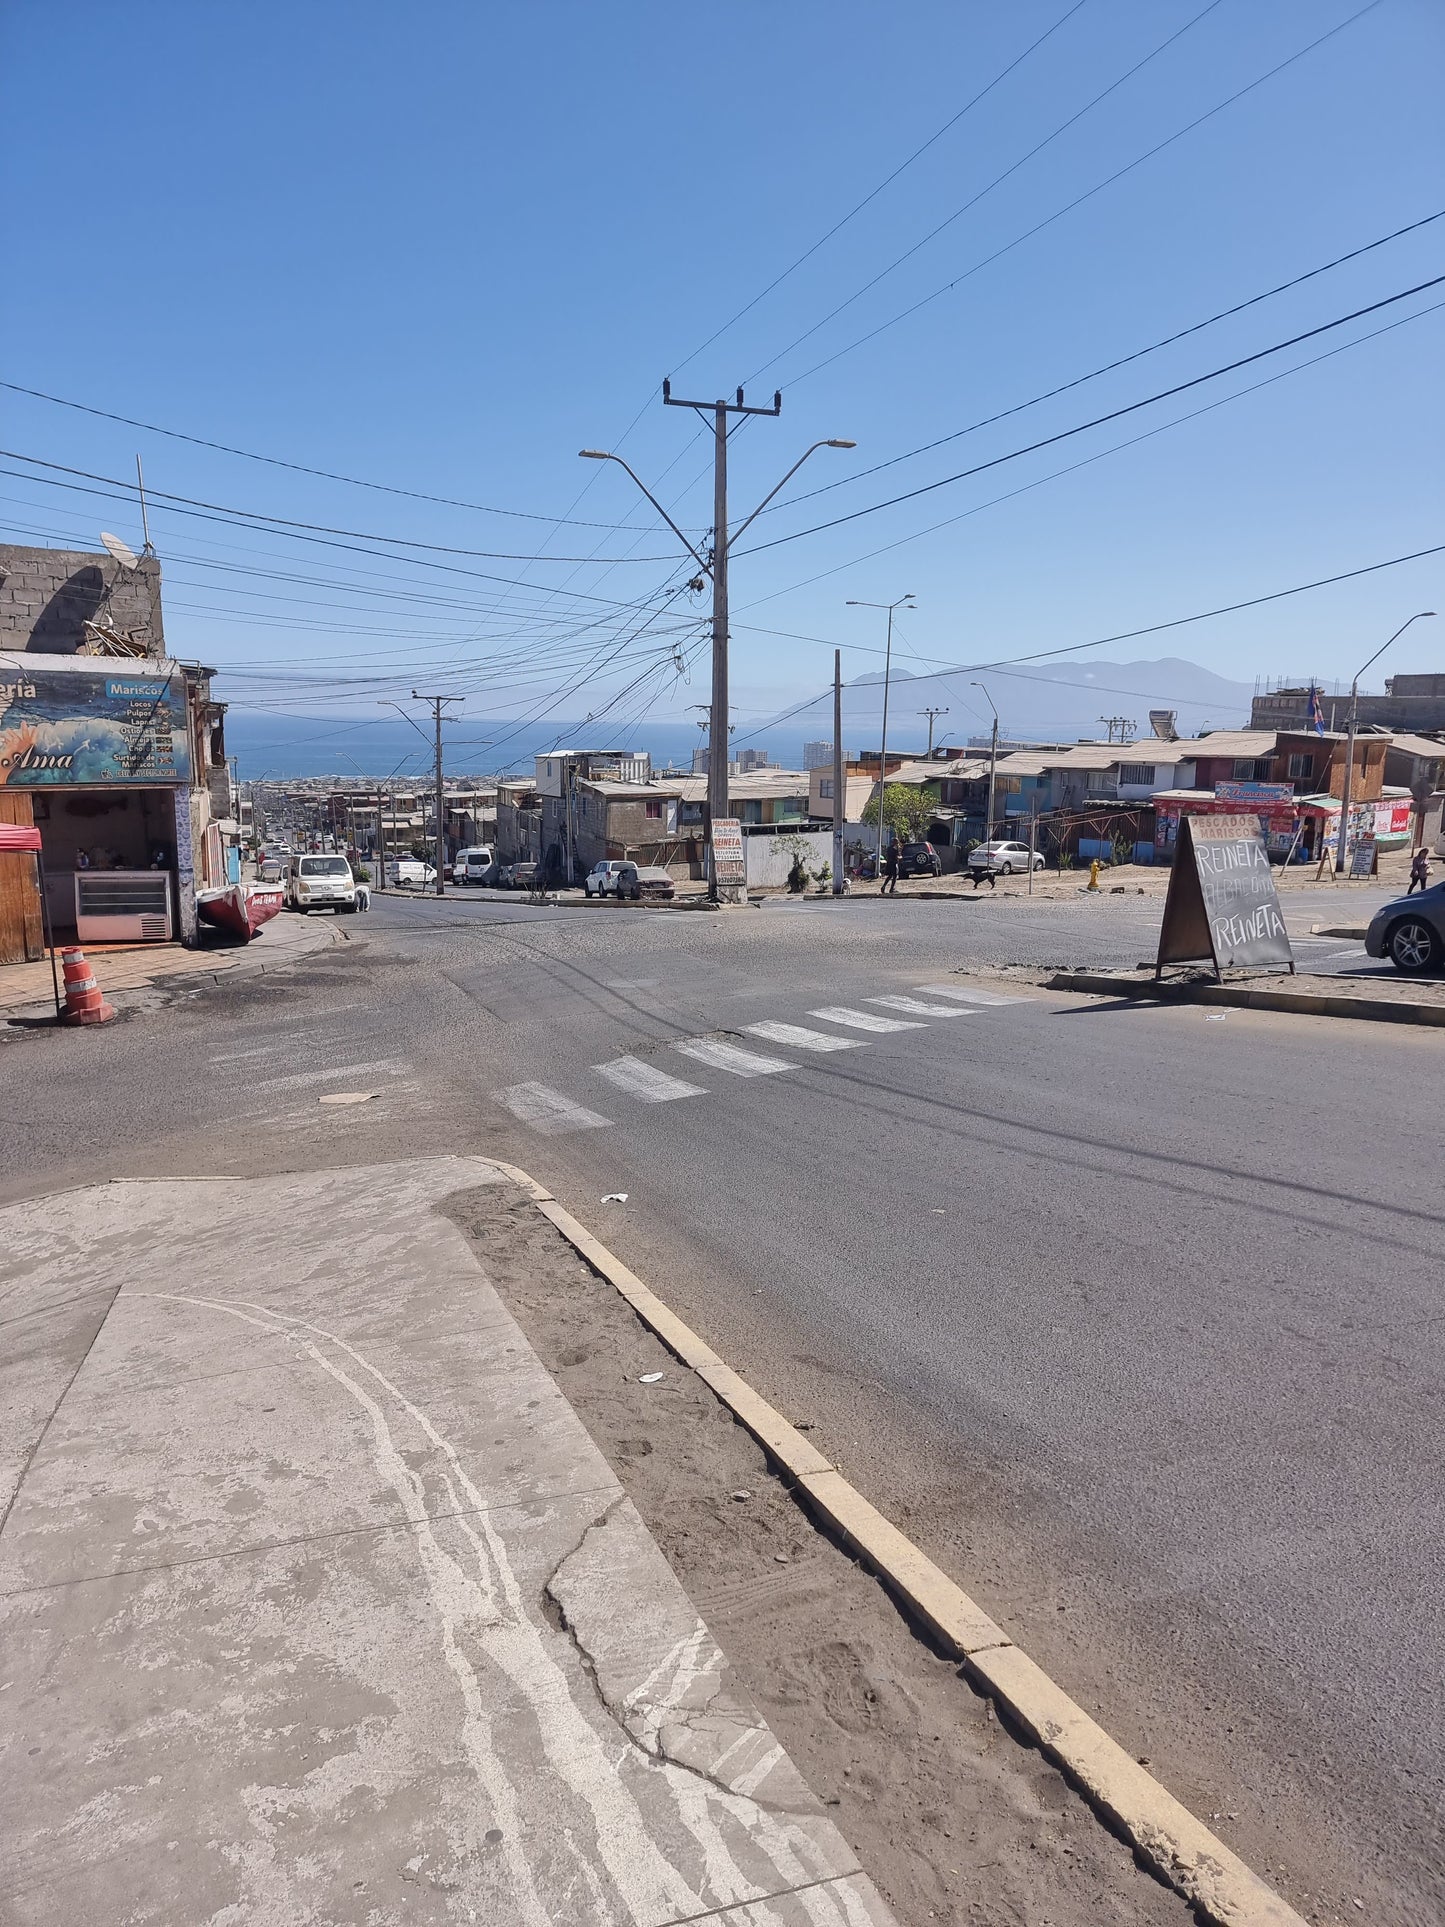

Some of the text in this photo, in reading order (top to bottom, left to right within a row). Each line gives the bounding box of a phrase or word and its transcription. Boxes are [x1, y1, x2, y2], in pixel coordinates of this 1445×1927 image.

[111, 684, 162, 696] Mariscos
[127, 710, 152, 718] Pulpos
[3, 744, 73, 769] Ama
[1193, 817, 1255, 828] PESCADOS
[1201, 827, 1259, 838] MARISCOS
[714, 837, 741, 846] REINETA
[1195, 840, 1269, 877] REINETA
[1212, 904, 1286, 950] REINETA
